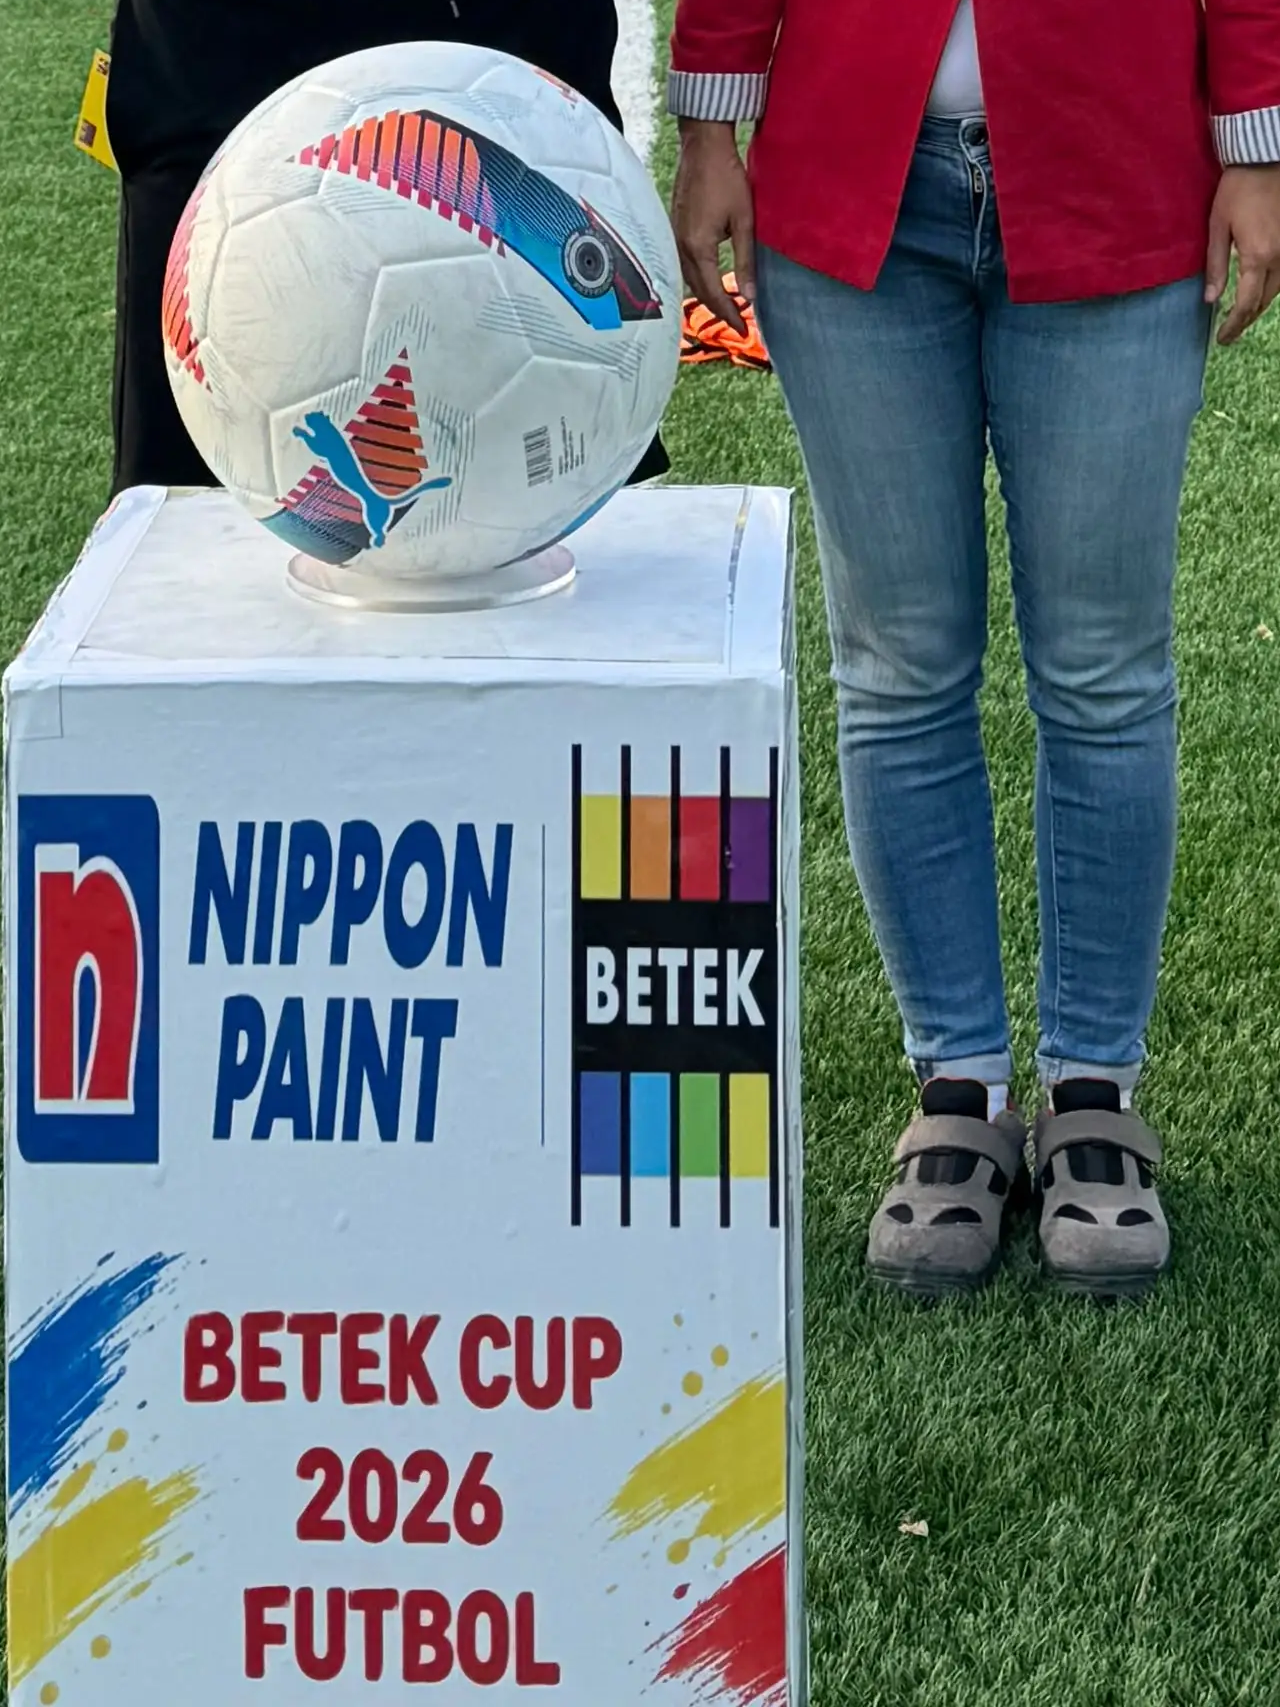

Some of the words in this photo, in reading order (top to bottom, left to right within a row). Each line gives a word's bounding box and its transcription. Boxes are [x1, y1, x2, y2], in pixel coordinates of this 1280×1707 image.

[188, 819, 513, 969] NIPPON
[585, 946, 766, 1027] BETEK
[212, 994, 458, 1143] PAINT
[184, 1313, 440, 1405] BETEK
[459, 1316, 622, 1410] CUP
[296, 1447, 504, 1546] 2026
[243, 1585, 560, 1686] FUTBOL
